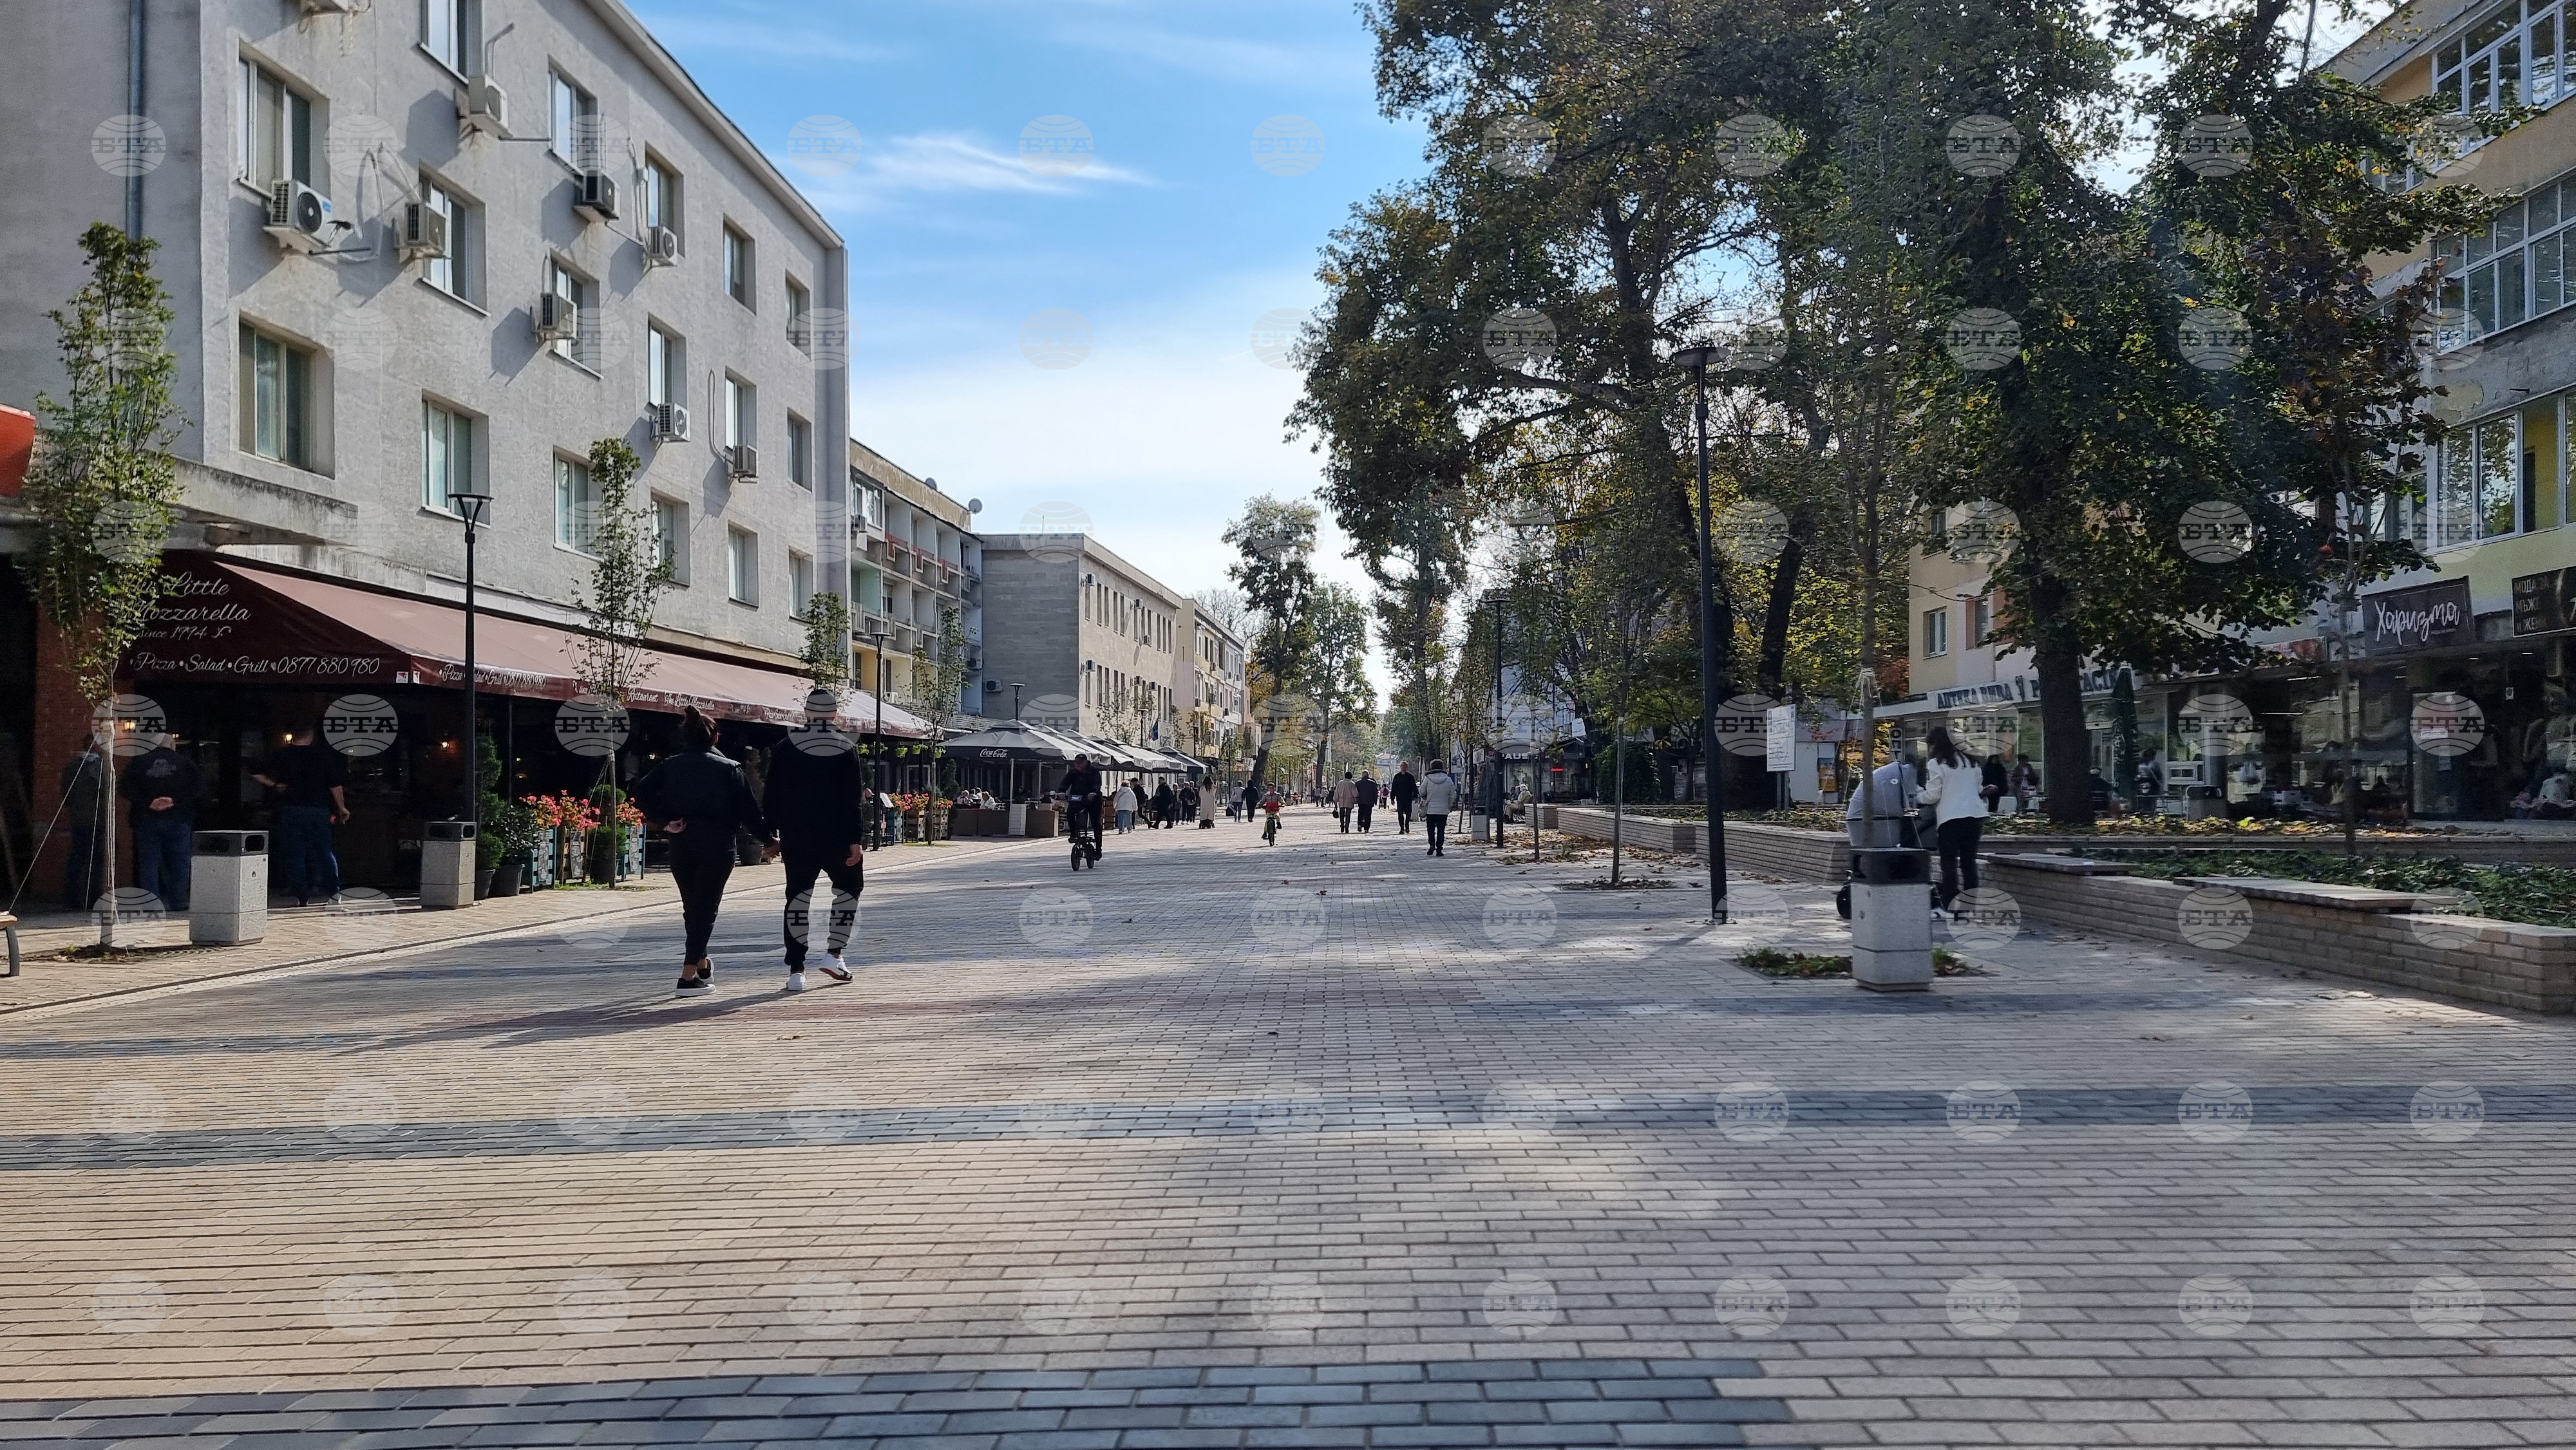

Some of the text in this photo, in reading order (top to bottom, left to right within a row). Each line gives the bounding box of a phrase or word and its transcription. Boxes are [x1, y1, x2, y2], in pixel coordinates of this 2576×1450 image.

[163, 571, 230, 597] Little
[134, 652, 176, 671] Pizza
[185, 654, 226, 672] Salad
[234, 655, 269, 675] Grill
[277, 657, 317, 674] 0877
[316, 657, 349, 674] 880
[350, 657, 380, 677] 980
